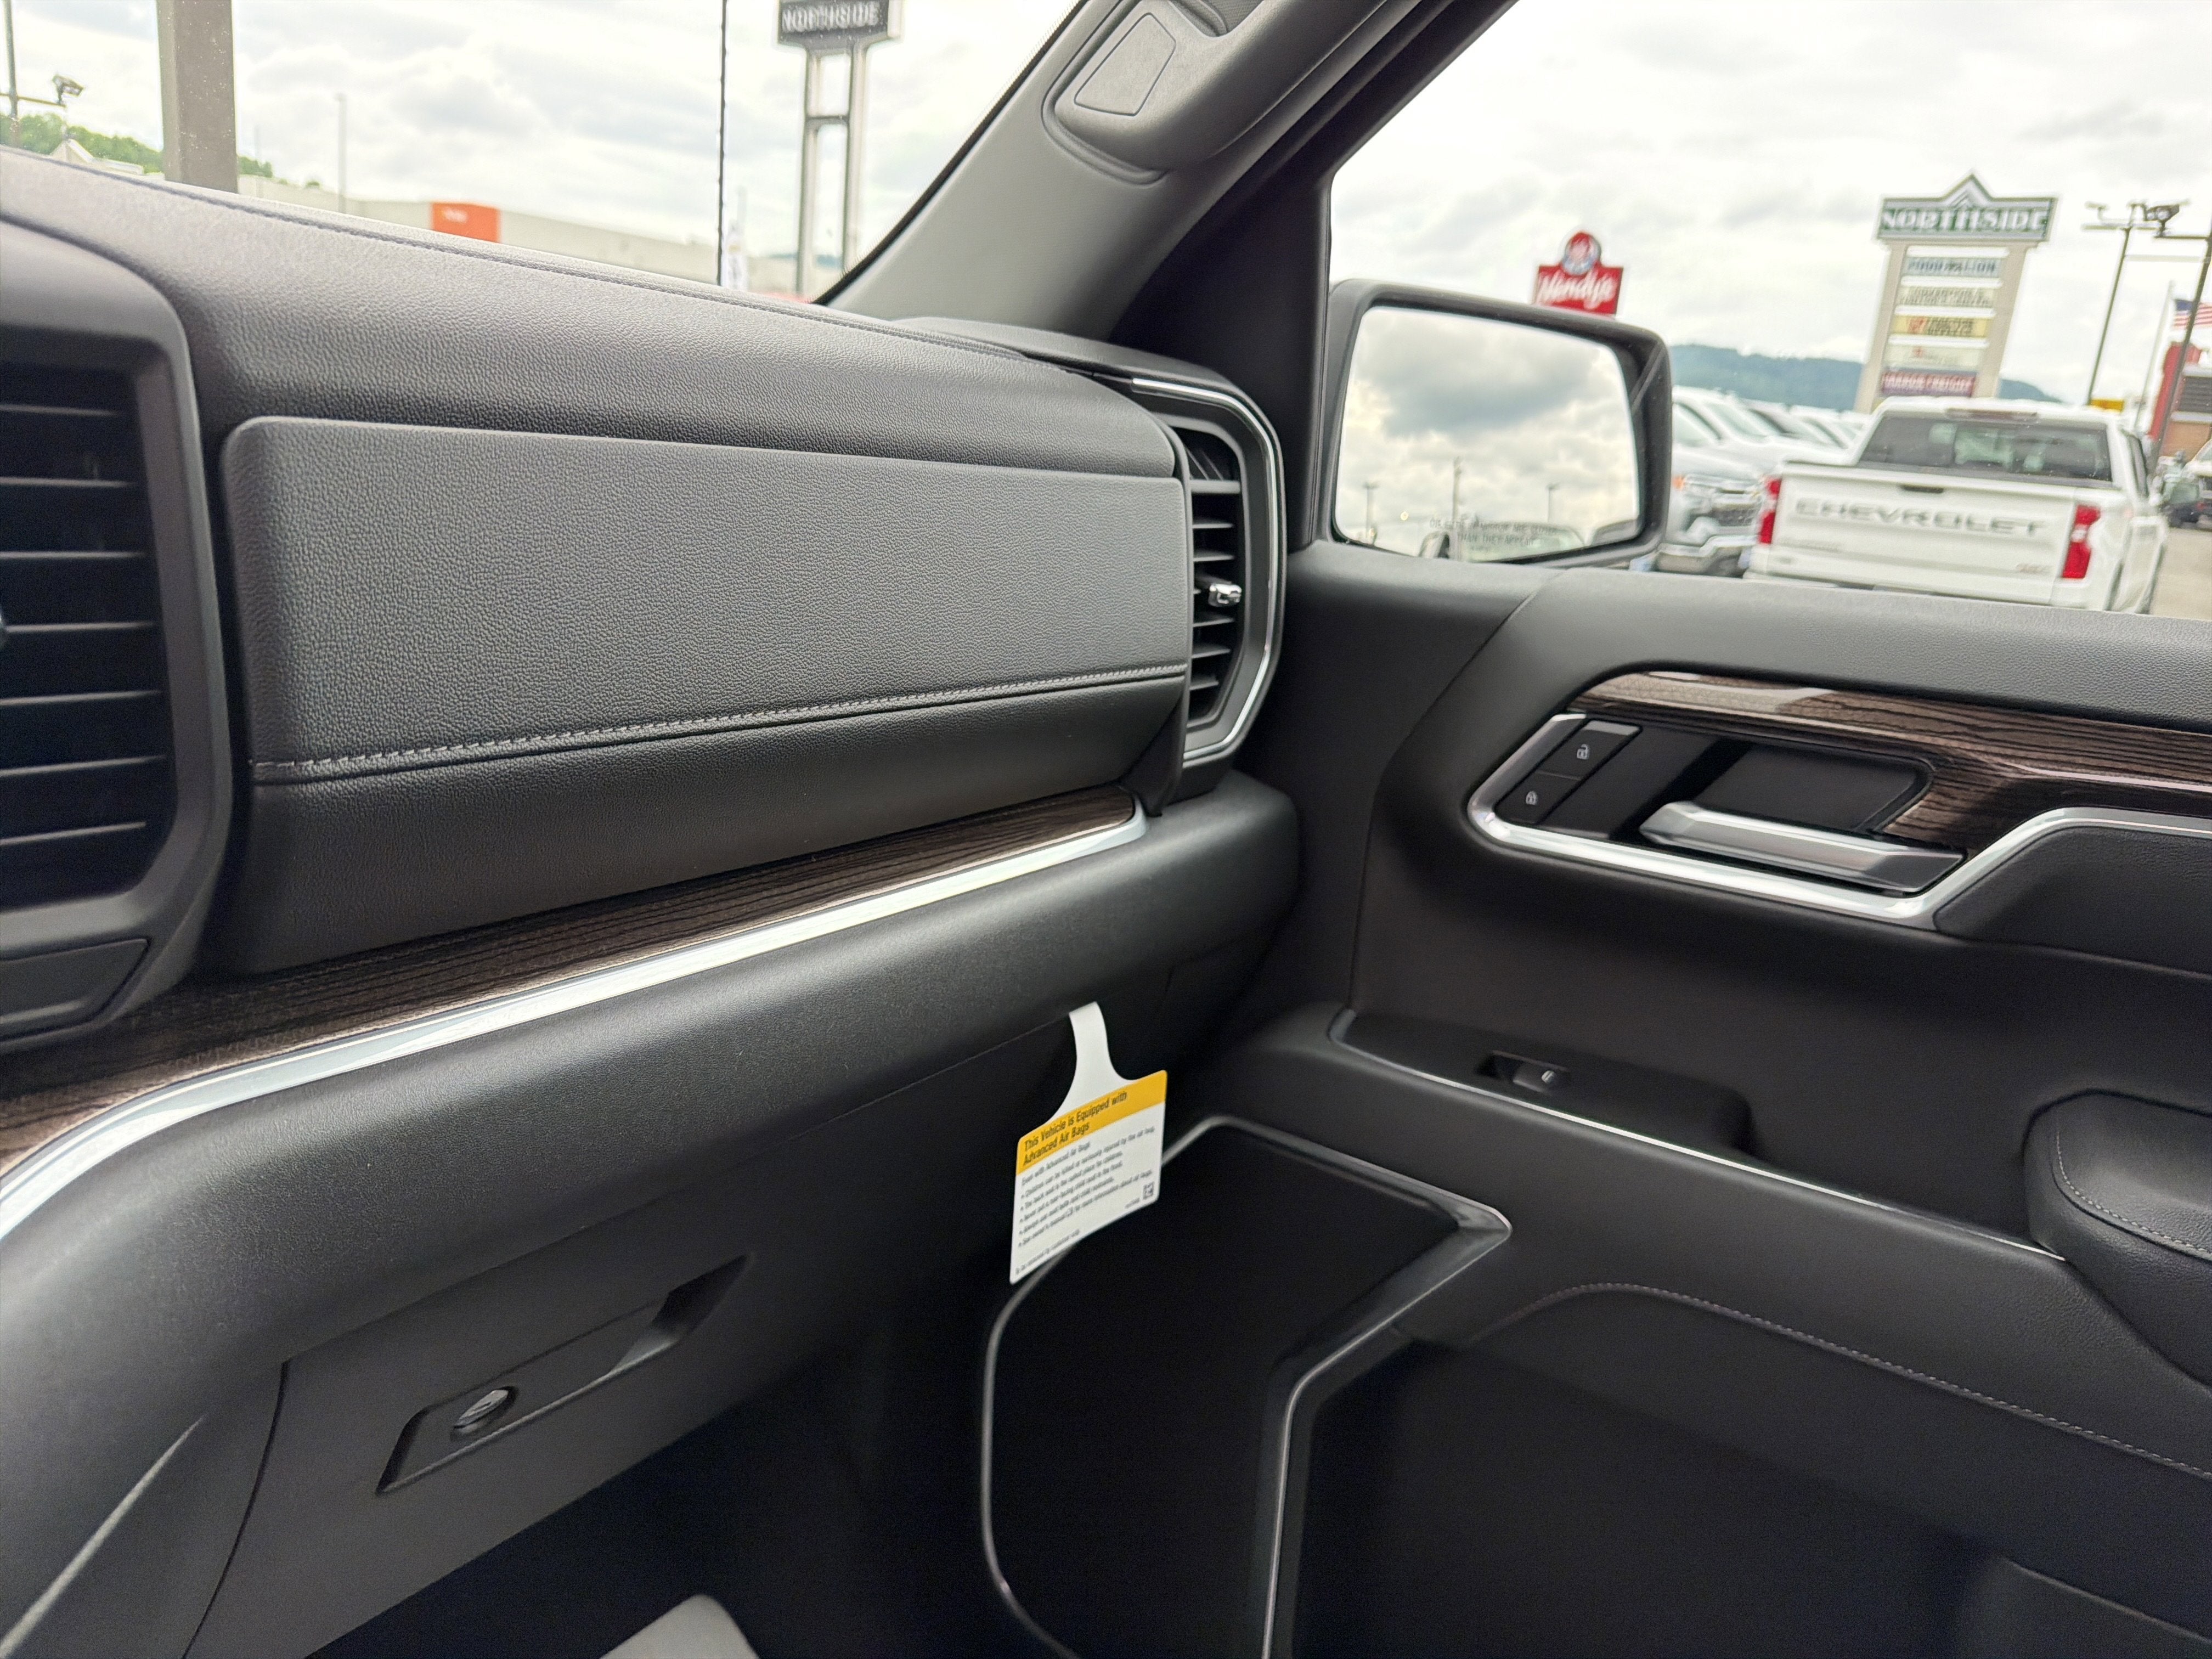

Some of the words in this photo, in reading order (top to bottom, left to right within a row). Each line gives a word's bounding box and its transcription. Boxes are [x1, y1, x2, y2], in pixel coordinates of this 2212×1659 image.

[782, 1, 880, 32] NORTHSIDE
[1881, 206, 2049, 231] NORTHSIDE
[1795, 497, 2049, 537] CHEVROLET
[1025, 1136, 1039, 1151] This
[1041, 1120, 1066, 1141] Vehicle
[1068, 1116, 1074, 1126] is
[1076, 1098, 1109, 1121] Equipped
[1112, 1091, 1127, 1105] with
[1024, 1137, 1058, 1165] Advanced
[1059, 1131, 1070, 1144] Air
[1071, 1122, 1090, 1138] Bags
